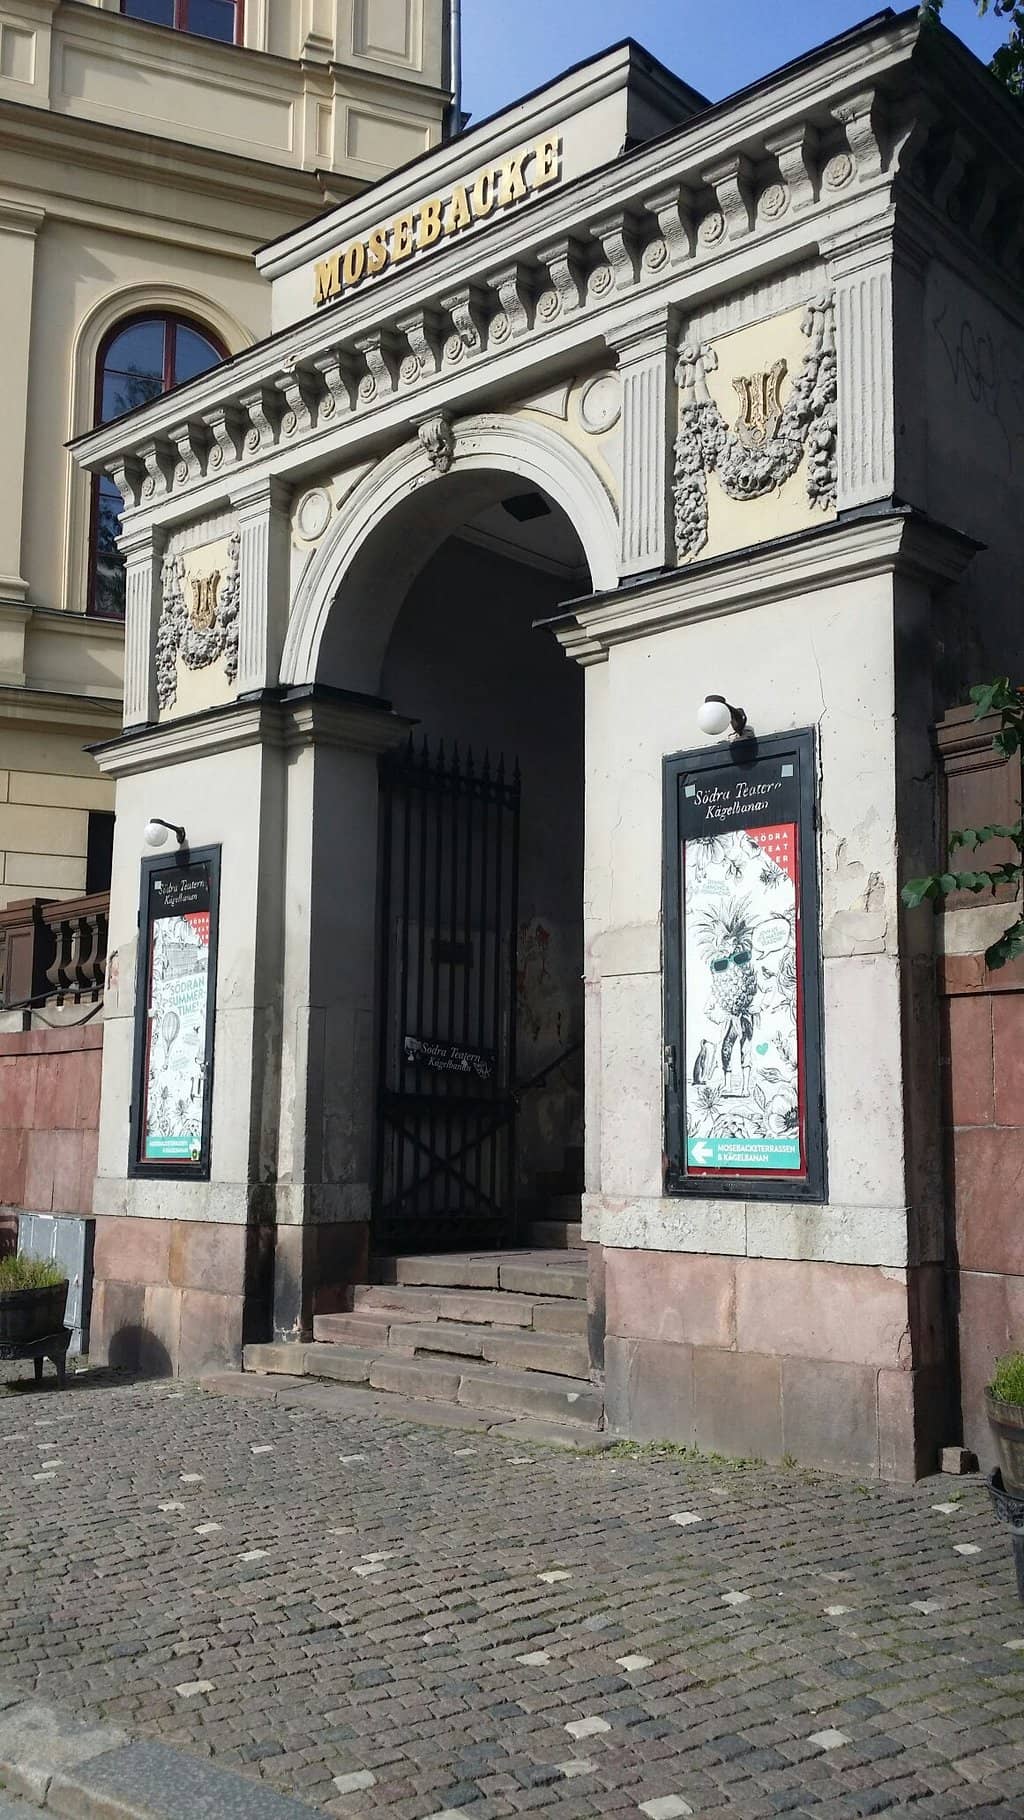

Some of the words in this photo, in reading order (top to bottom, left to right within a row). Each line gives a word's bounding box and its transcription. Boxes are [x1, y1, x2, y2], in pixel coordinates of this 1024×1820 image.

[312, 131, 562, 304] MOSEBACKE
[694, 787, 730, 805] Södra
[736, 782, 782, 799] Teatern
[705, 800, 769, 821] Kägelbanan
[171, 976, 205, 995] SÖDRAN
[422, 1042, 447, 1056] Södra
[450, 1047, 481, 1062] Teatern
